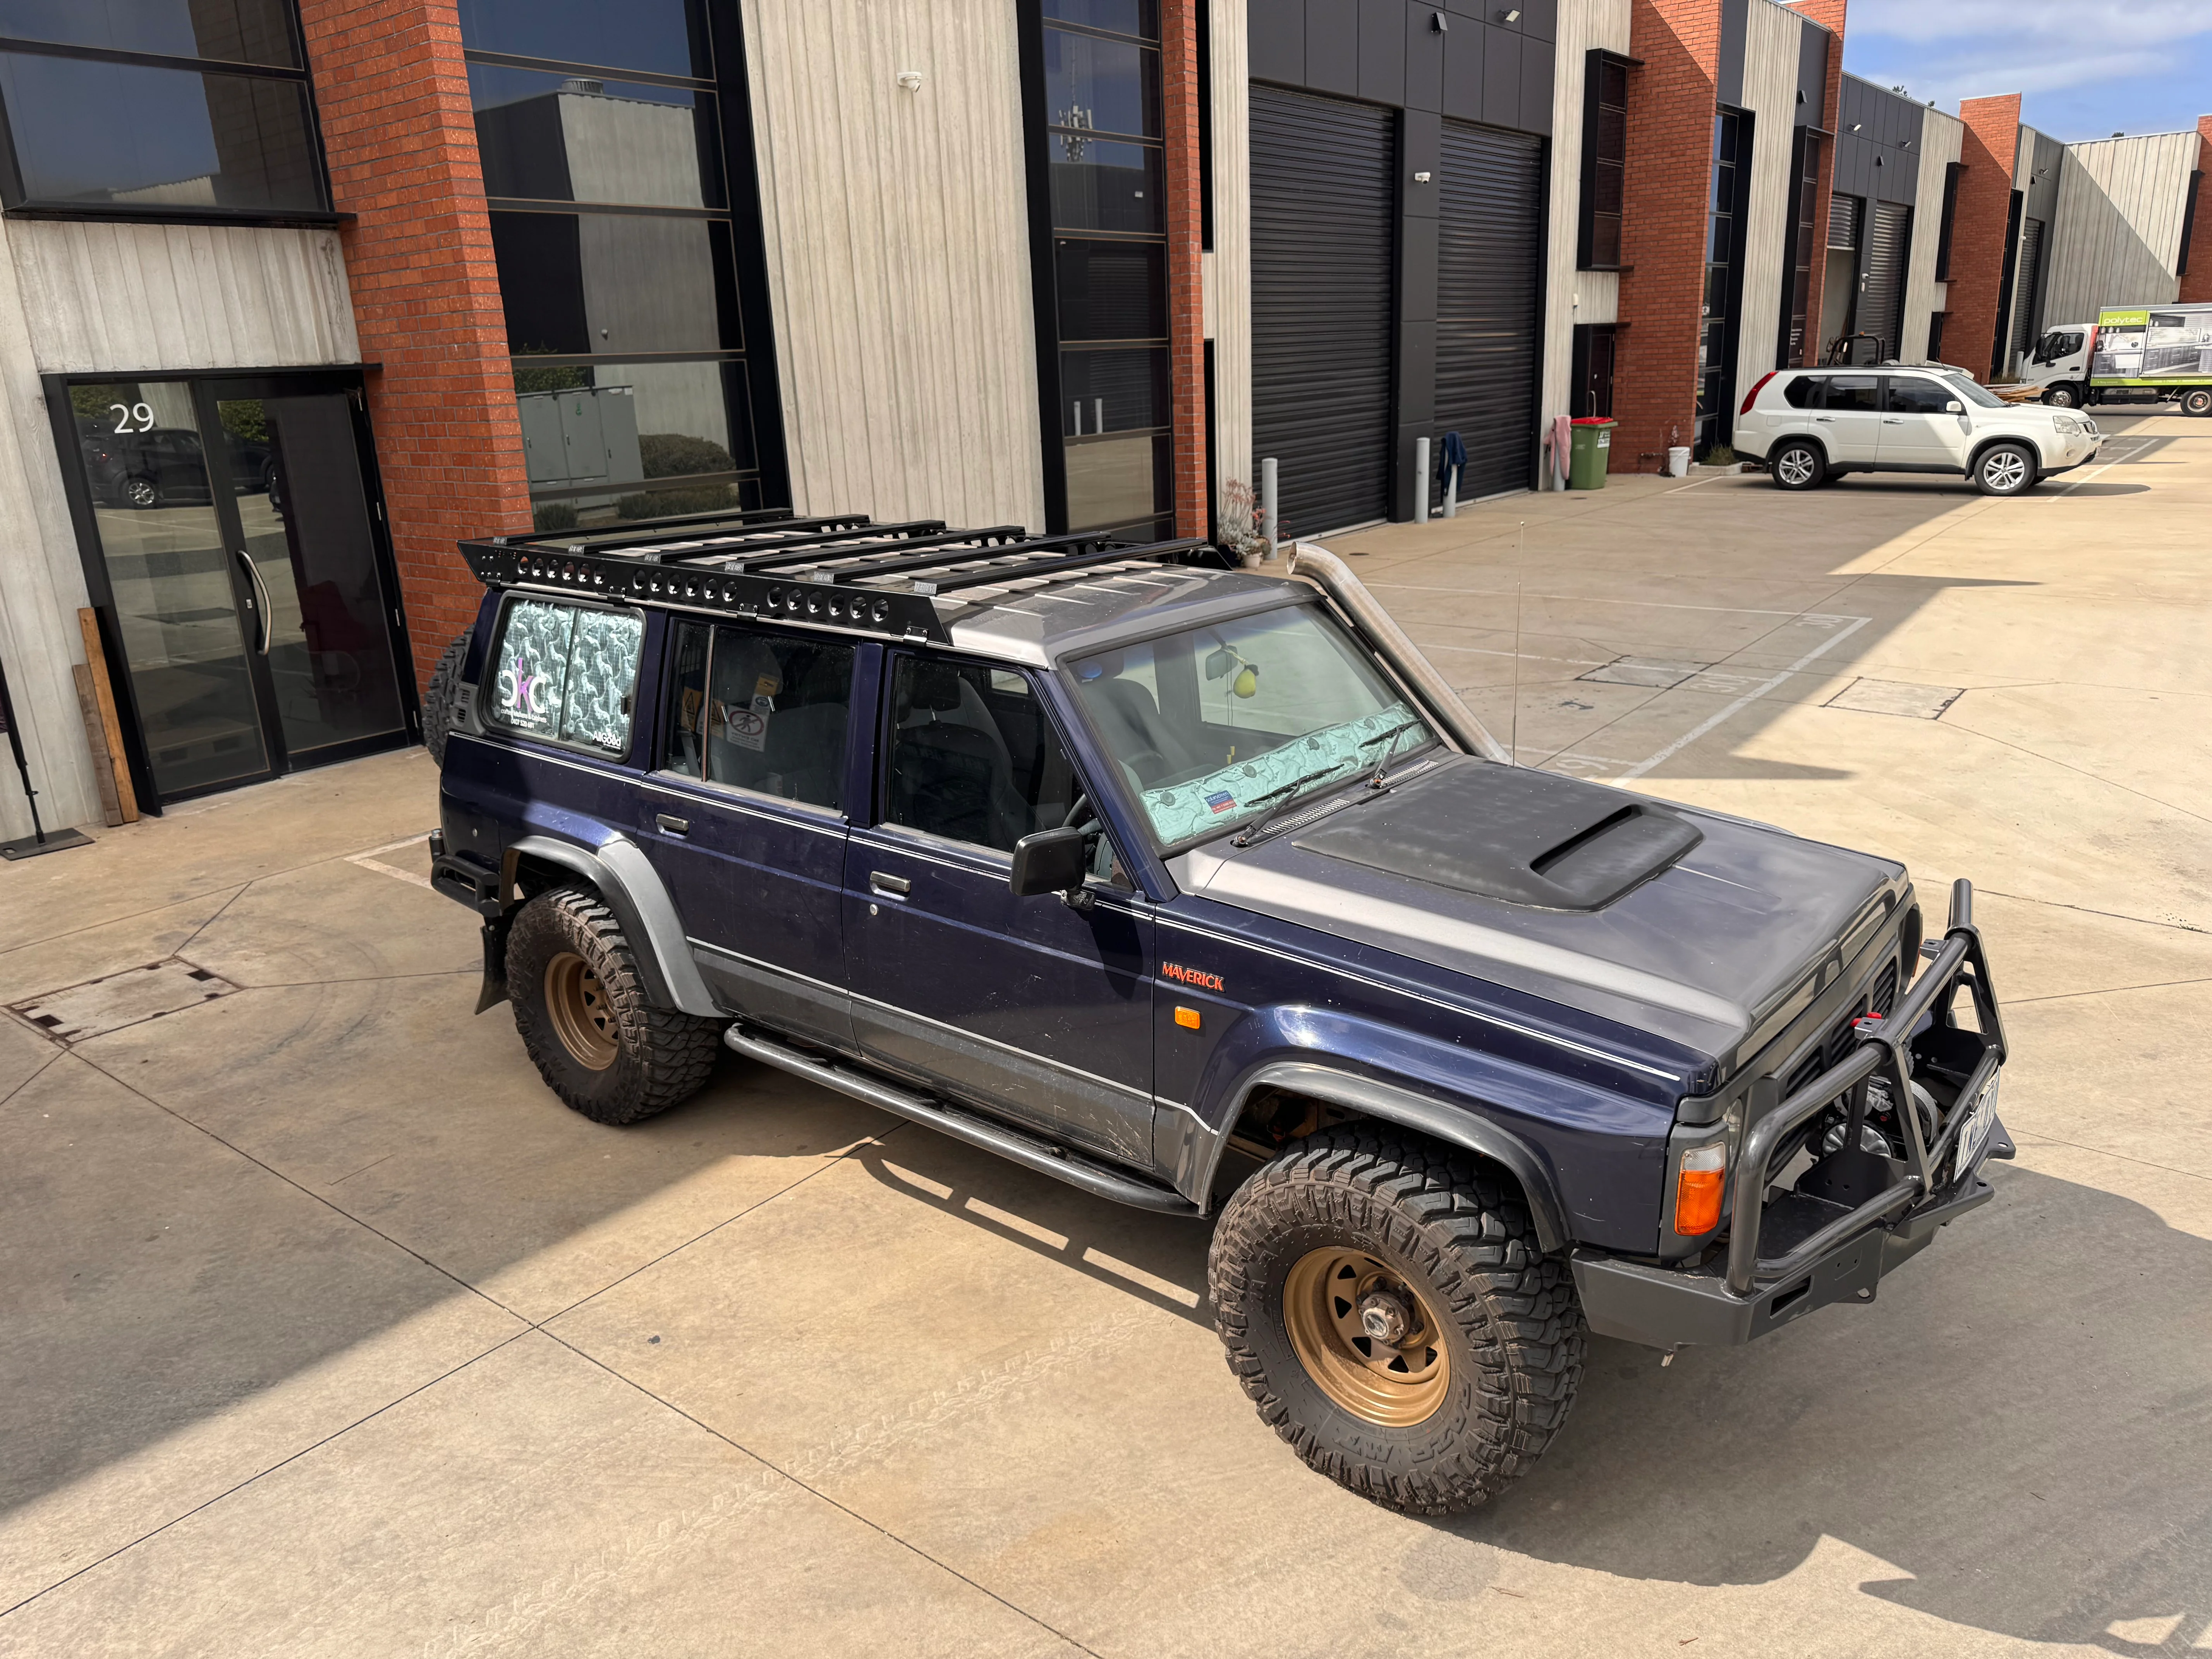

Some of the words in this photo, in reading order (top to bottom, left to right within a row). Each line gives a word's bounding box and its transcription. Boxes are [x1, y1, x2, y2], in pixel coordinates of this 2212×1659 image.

[2104, 316, 2143, 325] polytec
[110, 402, 154, 434] 29
[1162, 962, 1225, 992] MAVERICK
